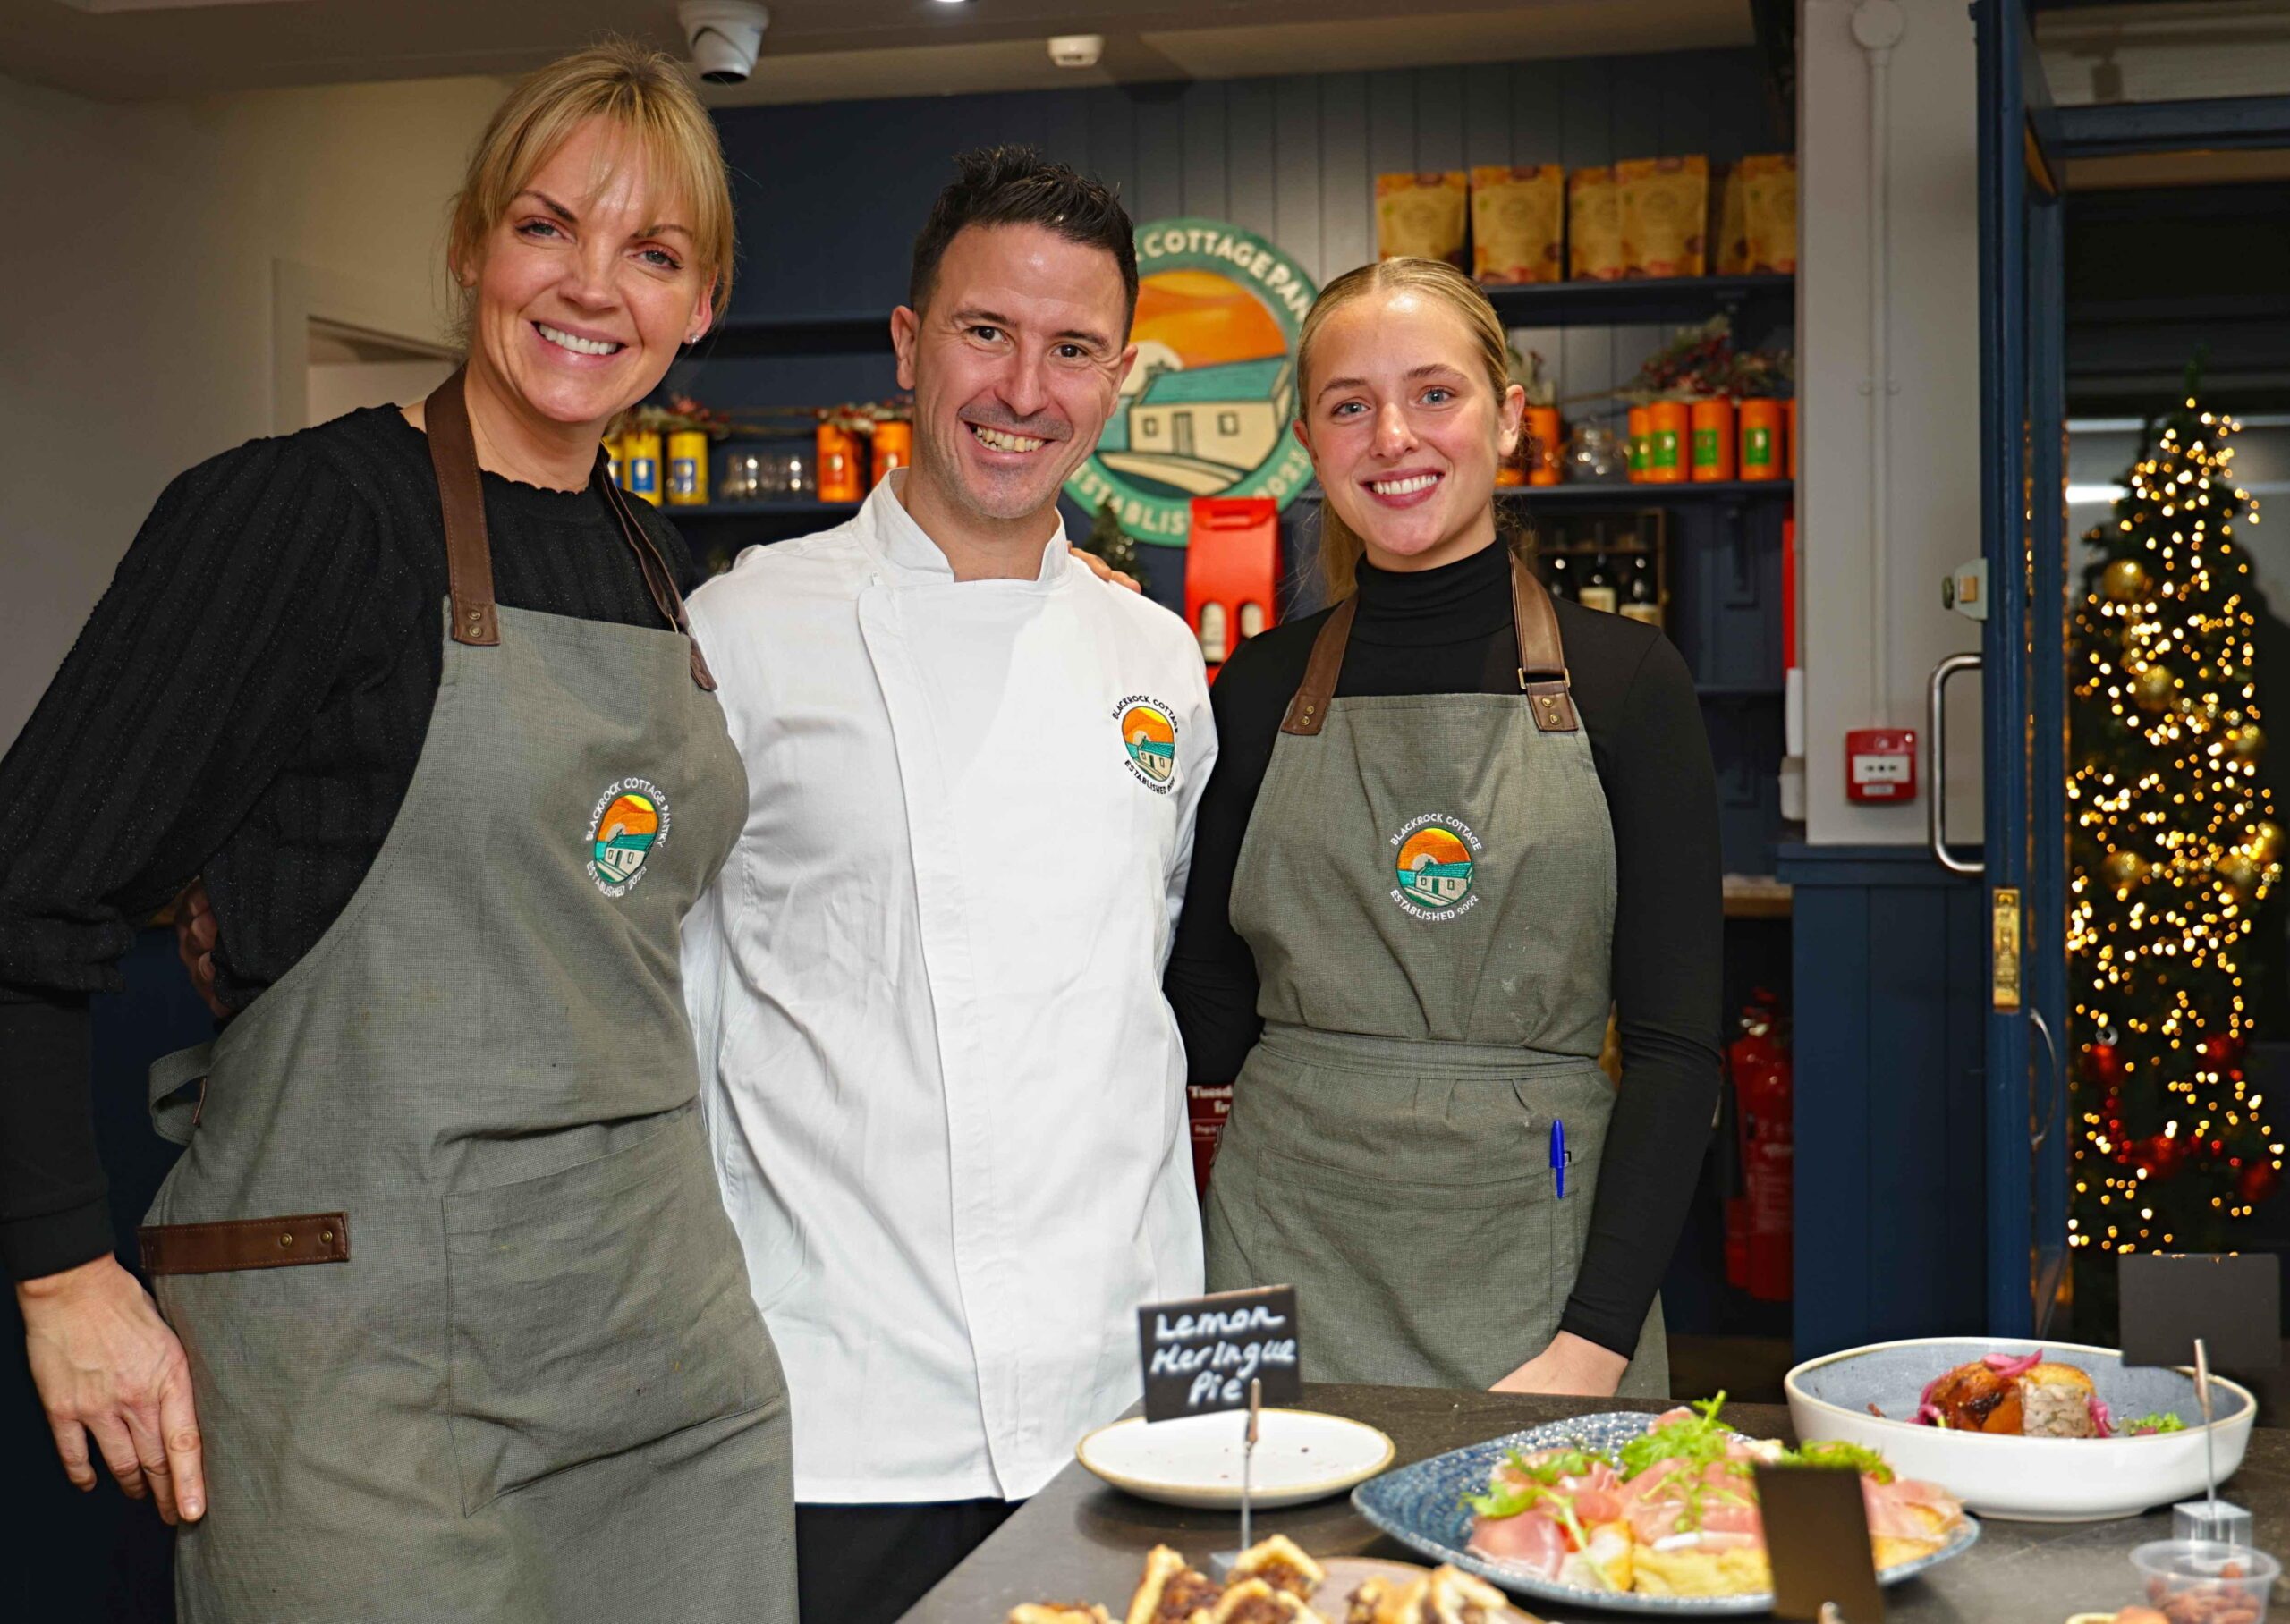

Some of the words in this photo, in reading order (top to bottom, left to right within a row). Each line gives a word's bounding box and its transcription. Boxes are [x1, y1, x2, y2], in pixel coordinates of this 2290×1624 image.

[1143, 228, 1274, 280] COTTAGE
[1265, 262, 1310, 322] PAN
[1071, 461, 1186, 535] ESTABLIS
[1112, 695, 1151, 720] BLACKROCK
[1124, 759, 1166, 795] ESTABLISHED
[585, 781, 622, 841] BLACKROCK
[624, 777, 666, 805] COTTAGE
[657, 804, 671, 847] PANTRY
[1390, 813, 1443, 845] BLACKROCK
[1446, 816, 1482, 851] COTTAGE
[587, 860, 625, 897] ESTABLISHED
[1390, 889, 1455, 921] ESTABLISHED
[1456, 895, 1479, 915] 2022
[1156, 1305, 1287, 1341] Lemon
[1187, 1370, 1243, 1408] Pie
